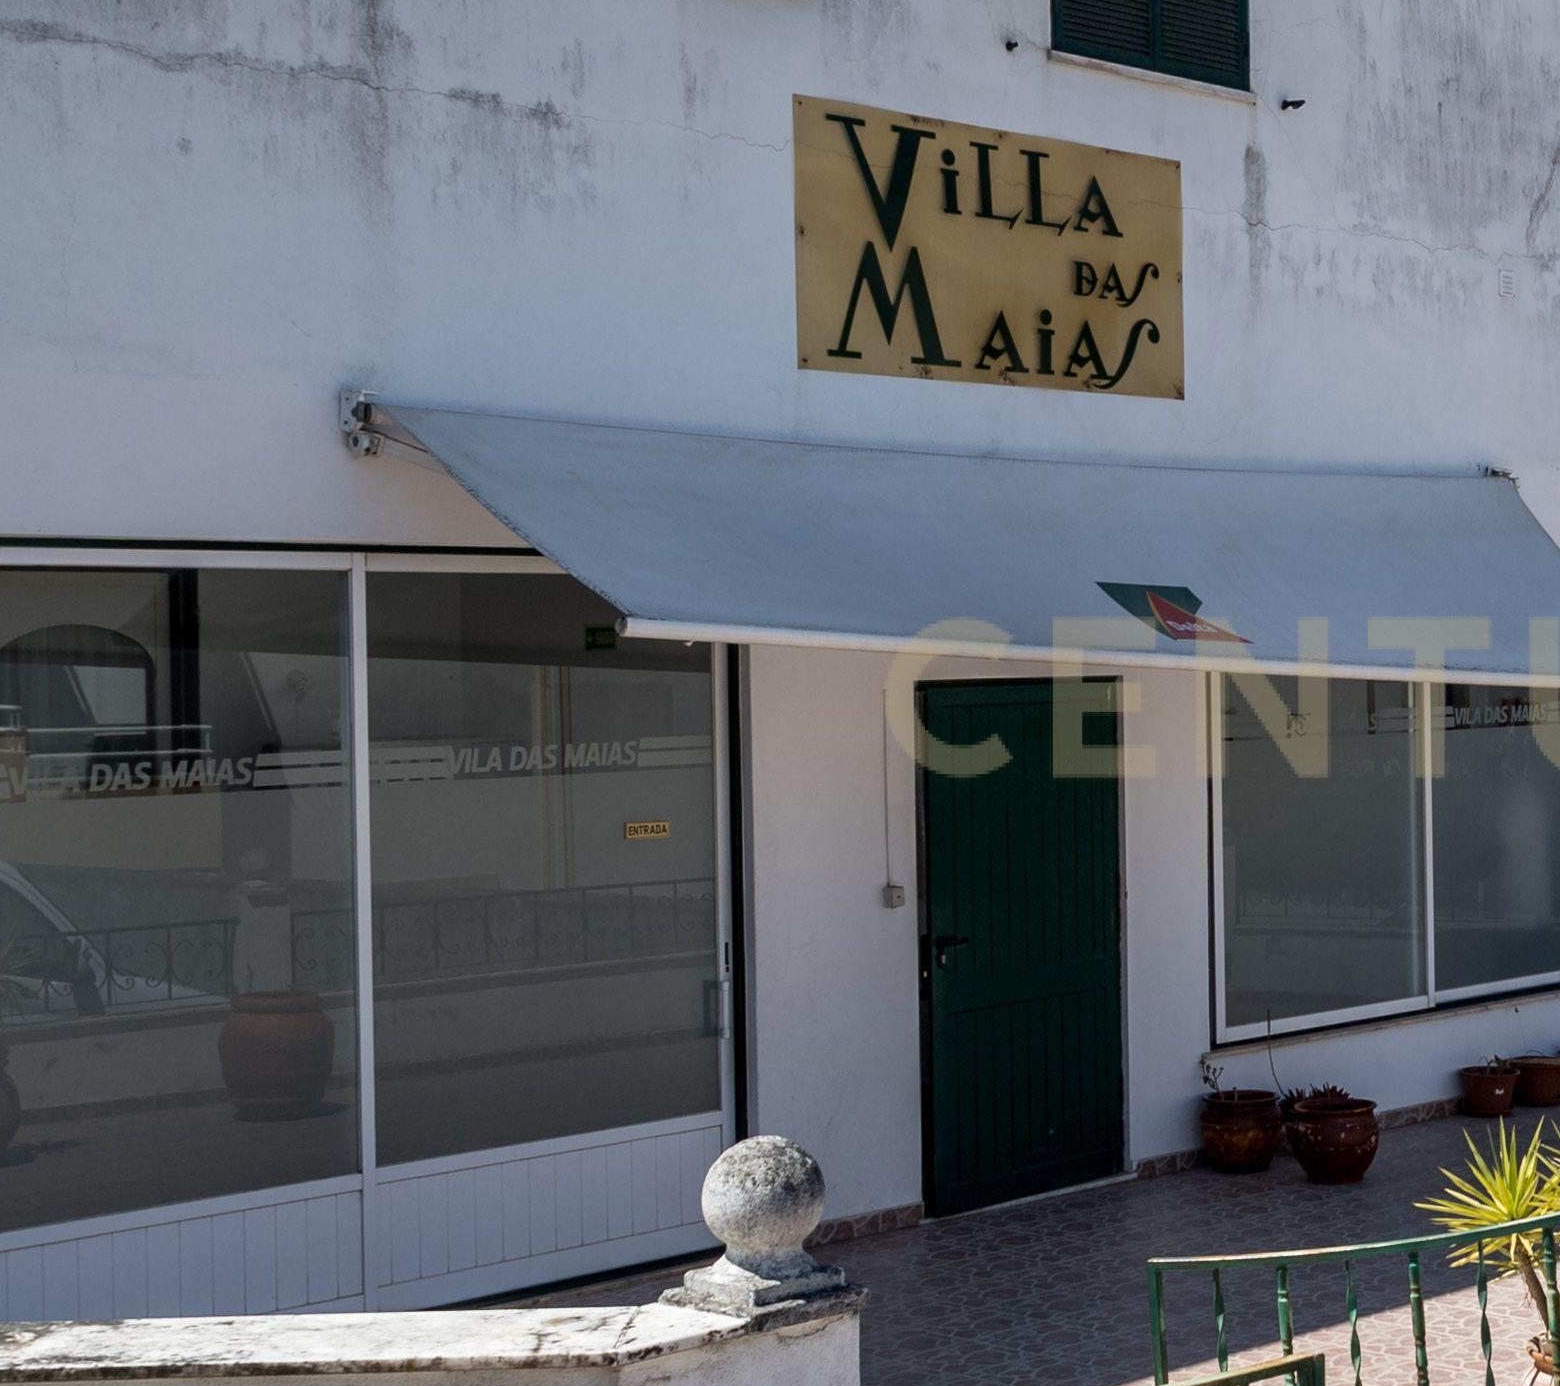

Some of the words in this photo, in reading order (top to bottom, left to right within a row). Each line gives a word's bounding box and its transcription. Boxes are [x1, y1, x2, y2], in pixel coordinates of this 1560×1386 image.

[1073, 260, 1160, 308] DAS
[1484, 705, 1508, 724] DAS
[450, 745, 504, 773] VILA
[509, 744, 559, 771] DAS
[563, 740, 639, 768] MAIAS
[90, 760, 153, 792] DAS
[159, 756, 255, 790] MAIAS
[628, 821, 668, 836] ENTRADA
